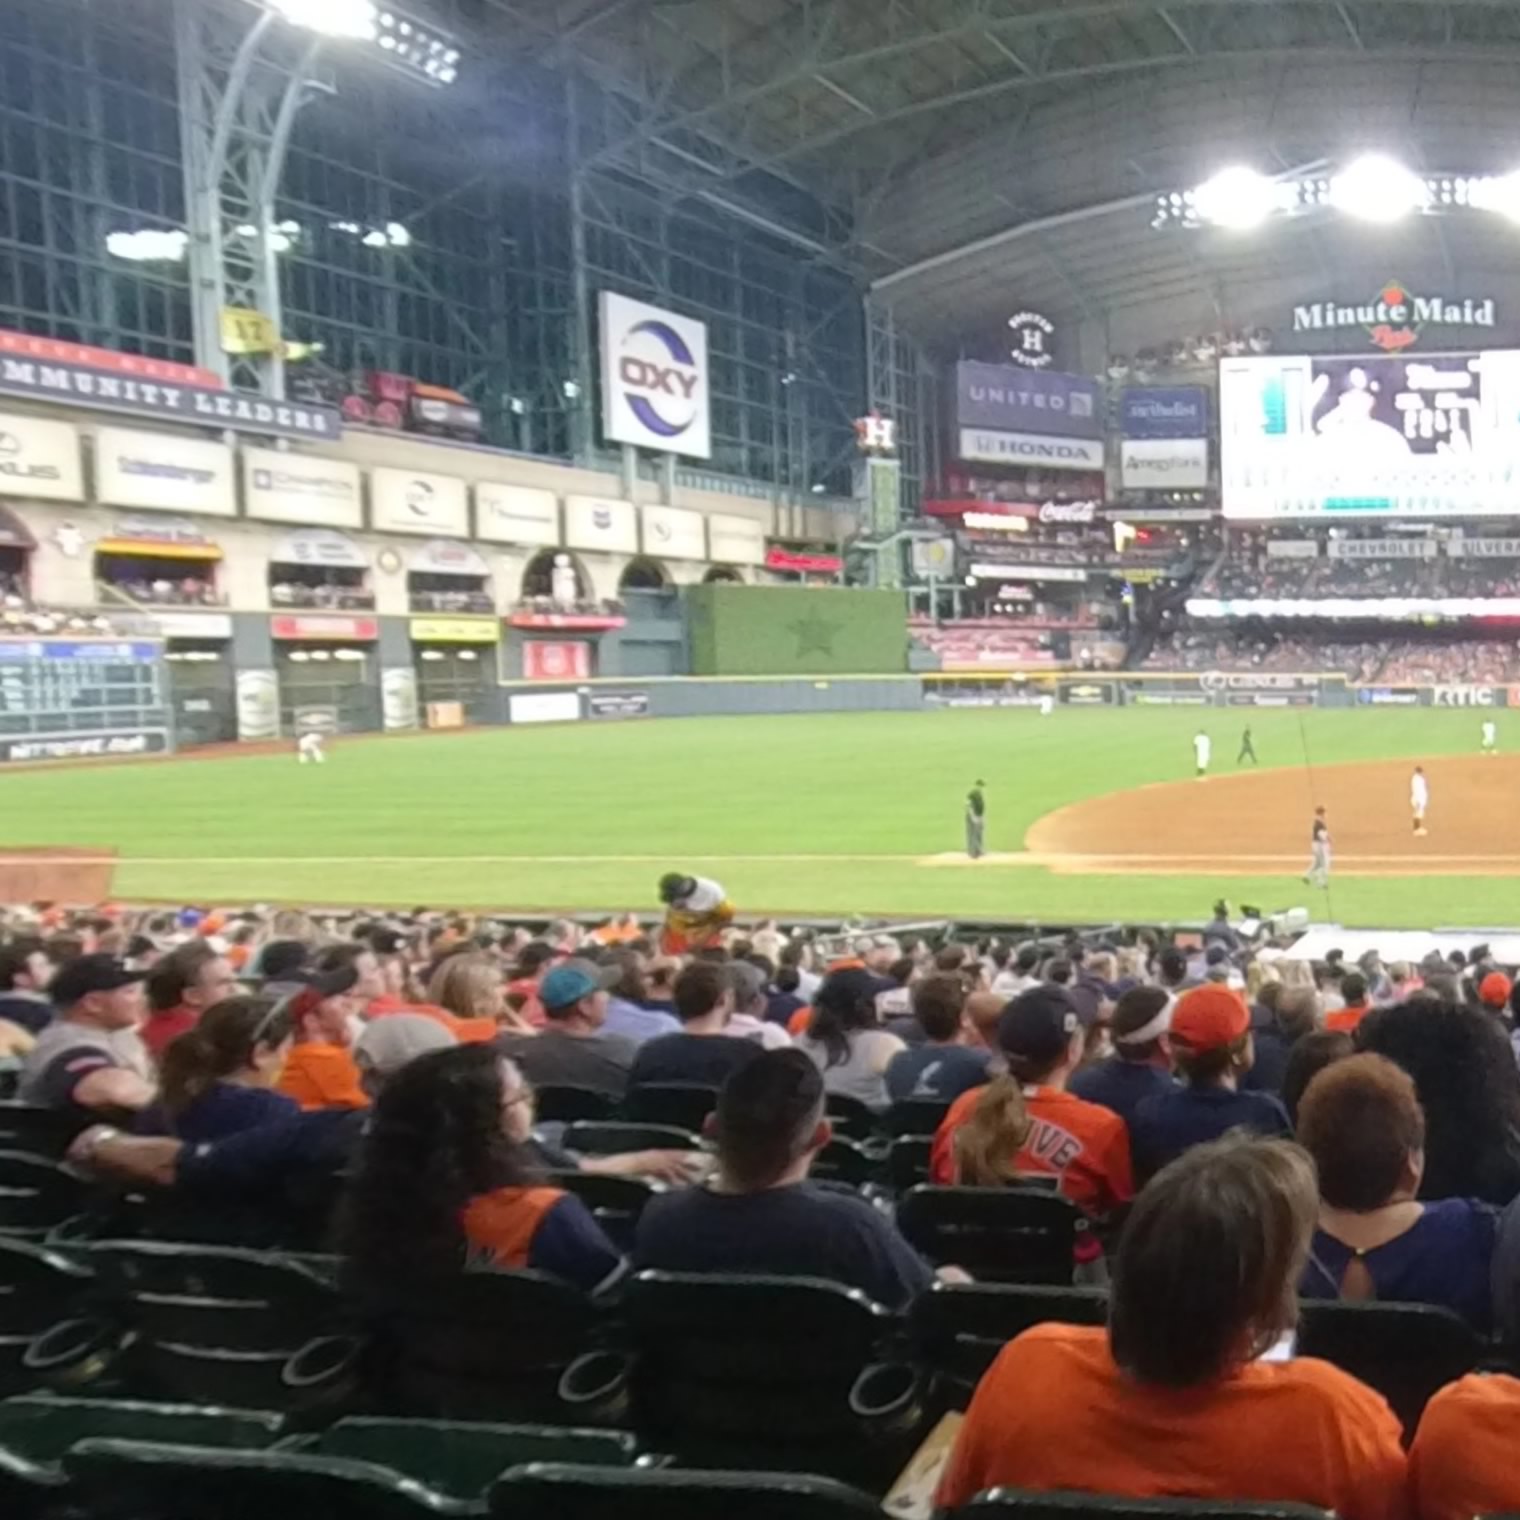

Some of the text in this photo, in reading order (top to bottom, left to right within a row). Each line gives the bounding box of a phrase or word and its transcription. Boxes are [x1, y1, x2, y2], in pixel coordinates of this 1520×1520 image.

[1293, 297, 1494, 331] Minute Maid
[1022, 329, 1043, 351] H
[619, 355, 698, 399] OXY
[969, 385, 1064, 409] UNITED
[194, 393, 327, 431] LEADERS
[1000, 441, 1091, 461] HONDA
[1337, 542, 1429, 555] CHEVROLET
